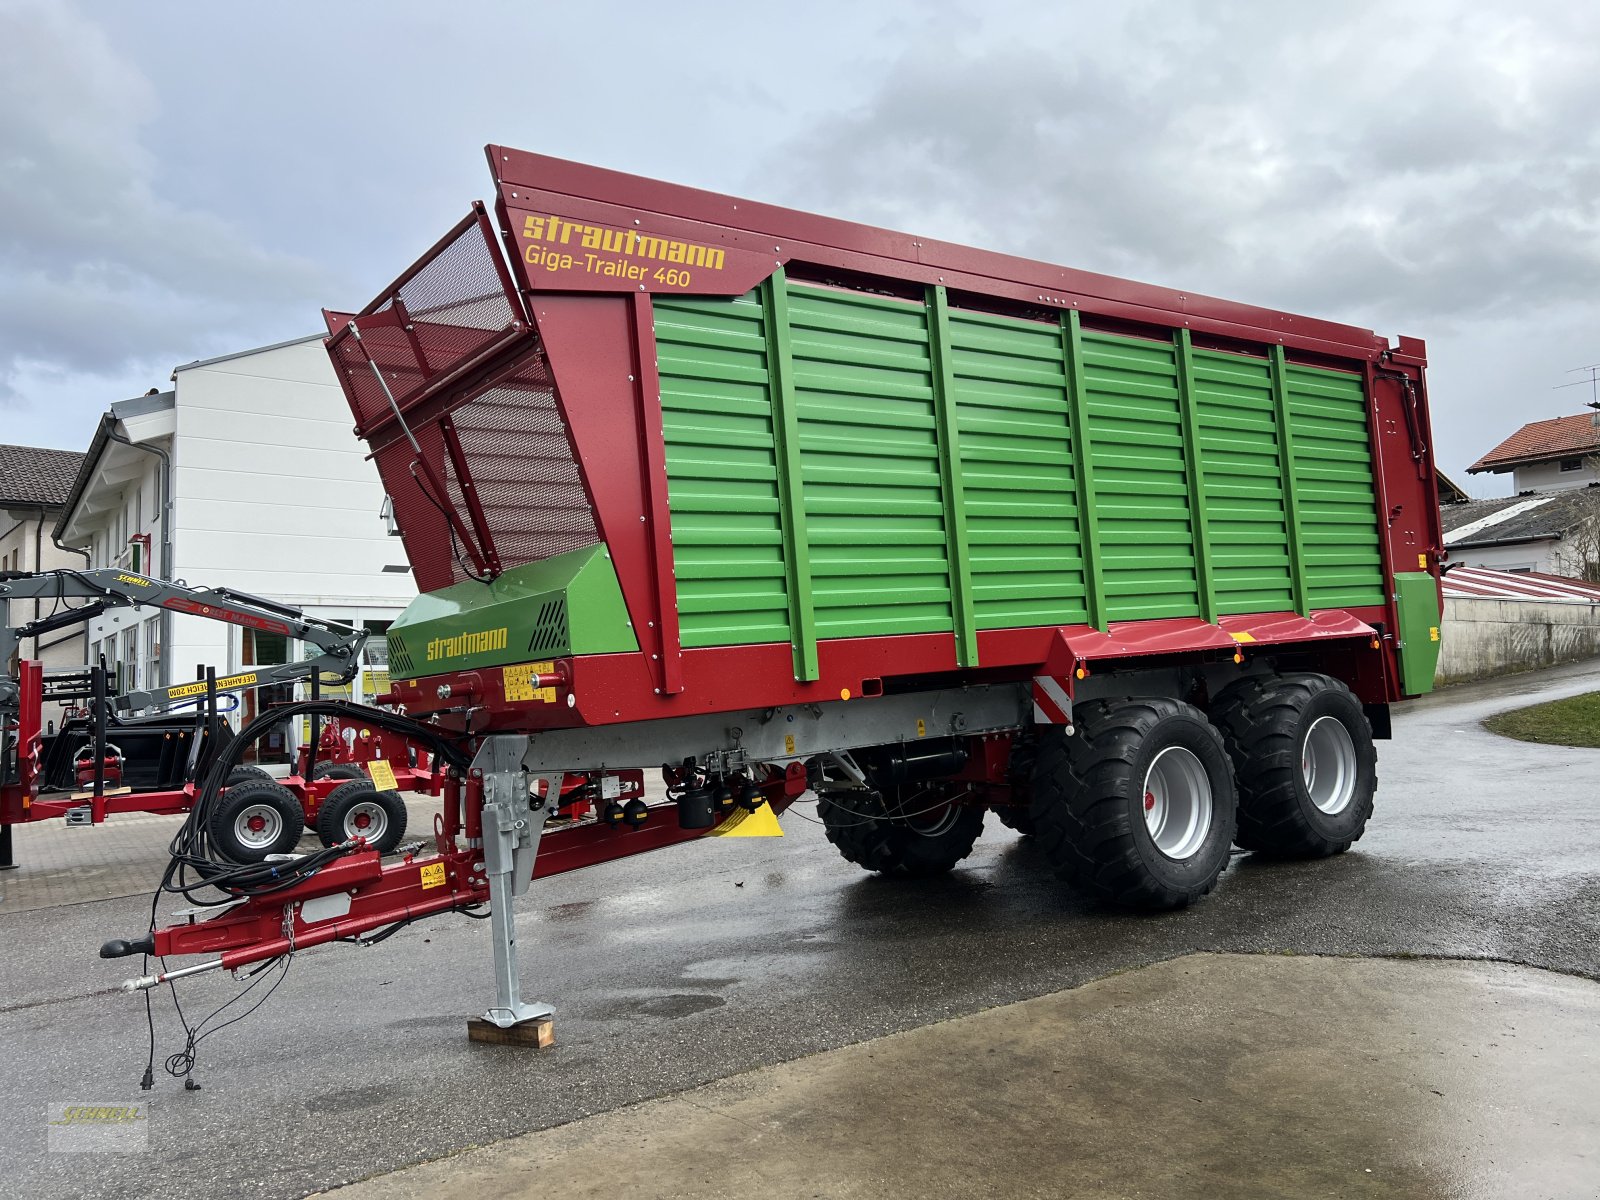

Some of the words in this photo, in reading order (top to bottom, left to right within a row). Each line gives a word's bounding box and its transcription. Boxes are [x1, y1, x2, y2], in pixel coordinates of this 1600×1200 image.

[522, 215, 725, 270] strautmann
[525, 245, 649, 281] Giga-Trailer
[653, 267, 691, 288] 460
[427, 628, 507, 660] strautmann
[169, 687, 186, 697] 20M
